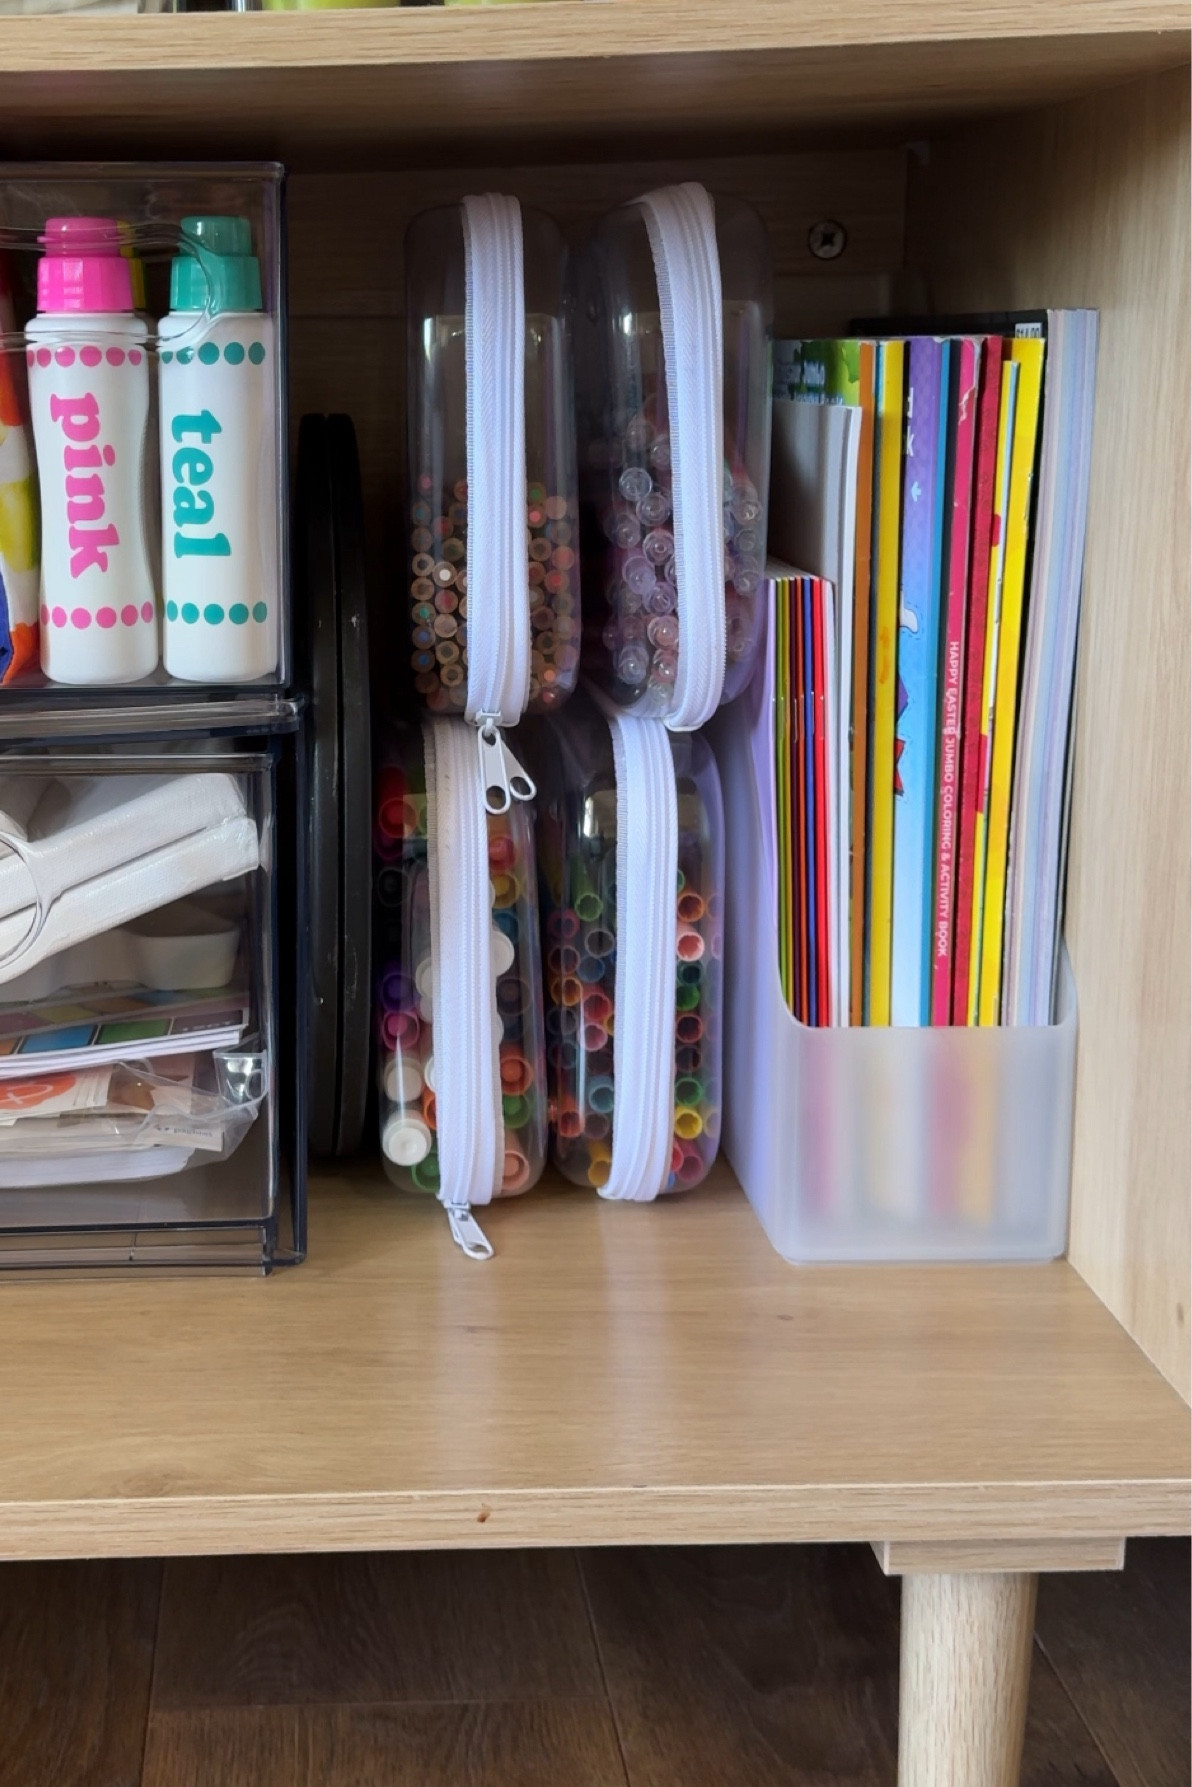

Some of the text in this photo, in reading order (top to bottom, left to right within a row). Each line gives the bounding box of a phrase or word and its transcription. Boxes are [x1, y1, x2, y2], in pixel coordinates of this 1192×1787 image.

[50, 392, 120, 579] pink
[171, 410, 232, 559] teal
[937, 641, 960, 957] HAPPY EASTER JUMBO COLORING & ACTIVITY BOOK
